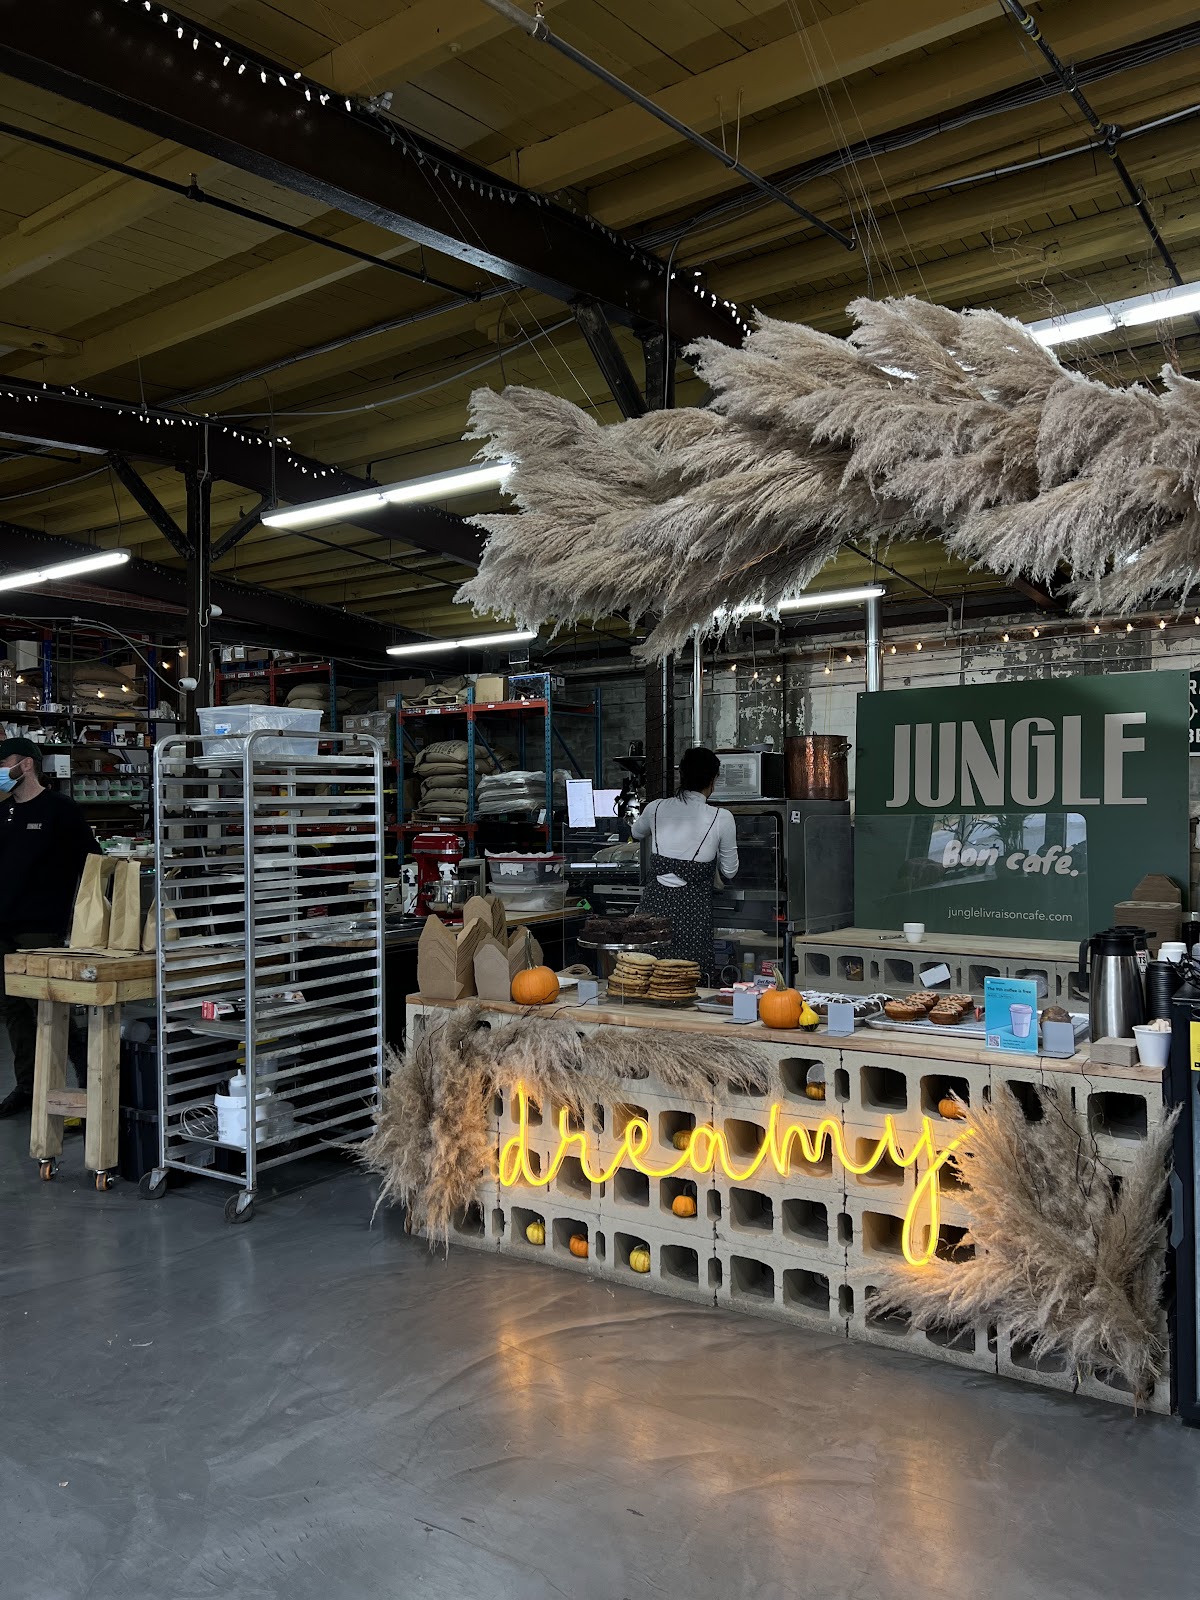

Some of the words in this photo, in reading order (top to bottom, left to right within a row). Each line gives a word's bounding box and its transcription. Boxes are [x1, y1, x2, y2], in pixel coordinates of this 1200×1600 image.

[886, 712, 1147, 807] JUNGLE
[943, 840, 999, 868] Bon
[1006, 845, 1079, 877] café.
[948, 907, 1073, 922] junglelivraisoncafe.com
[499, 1081, 975, 1265] dreamy
